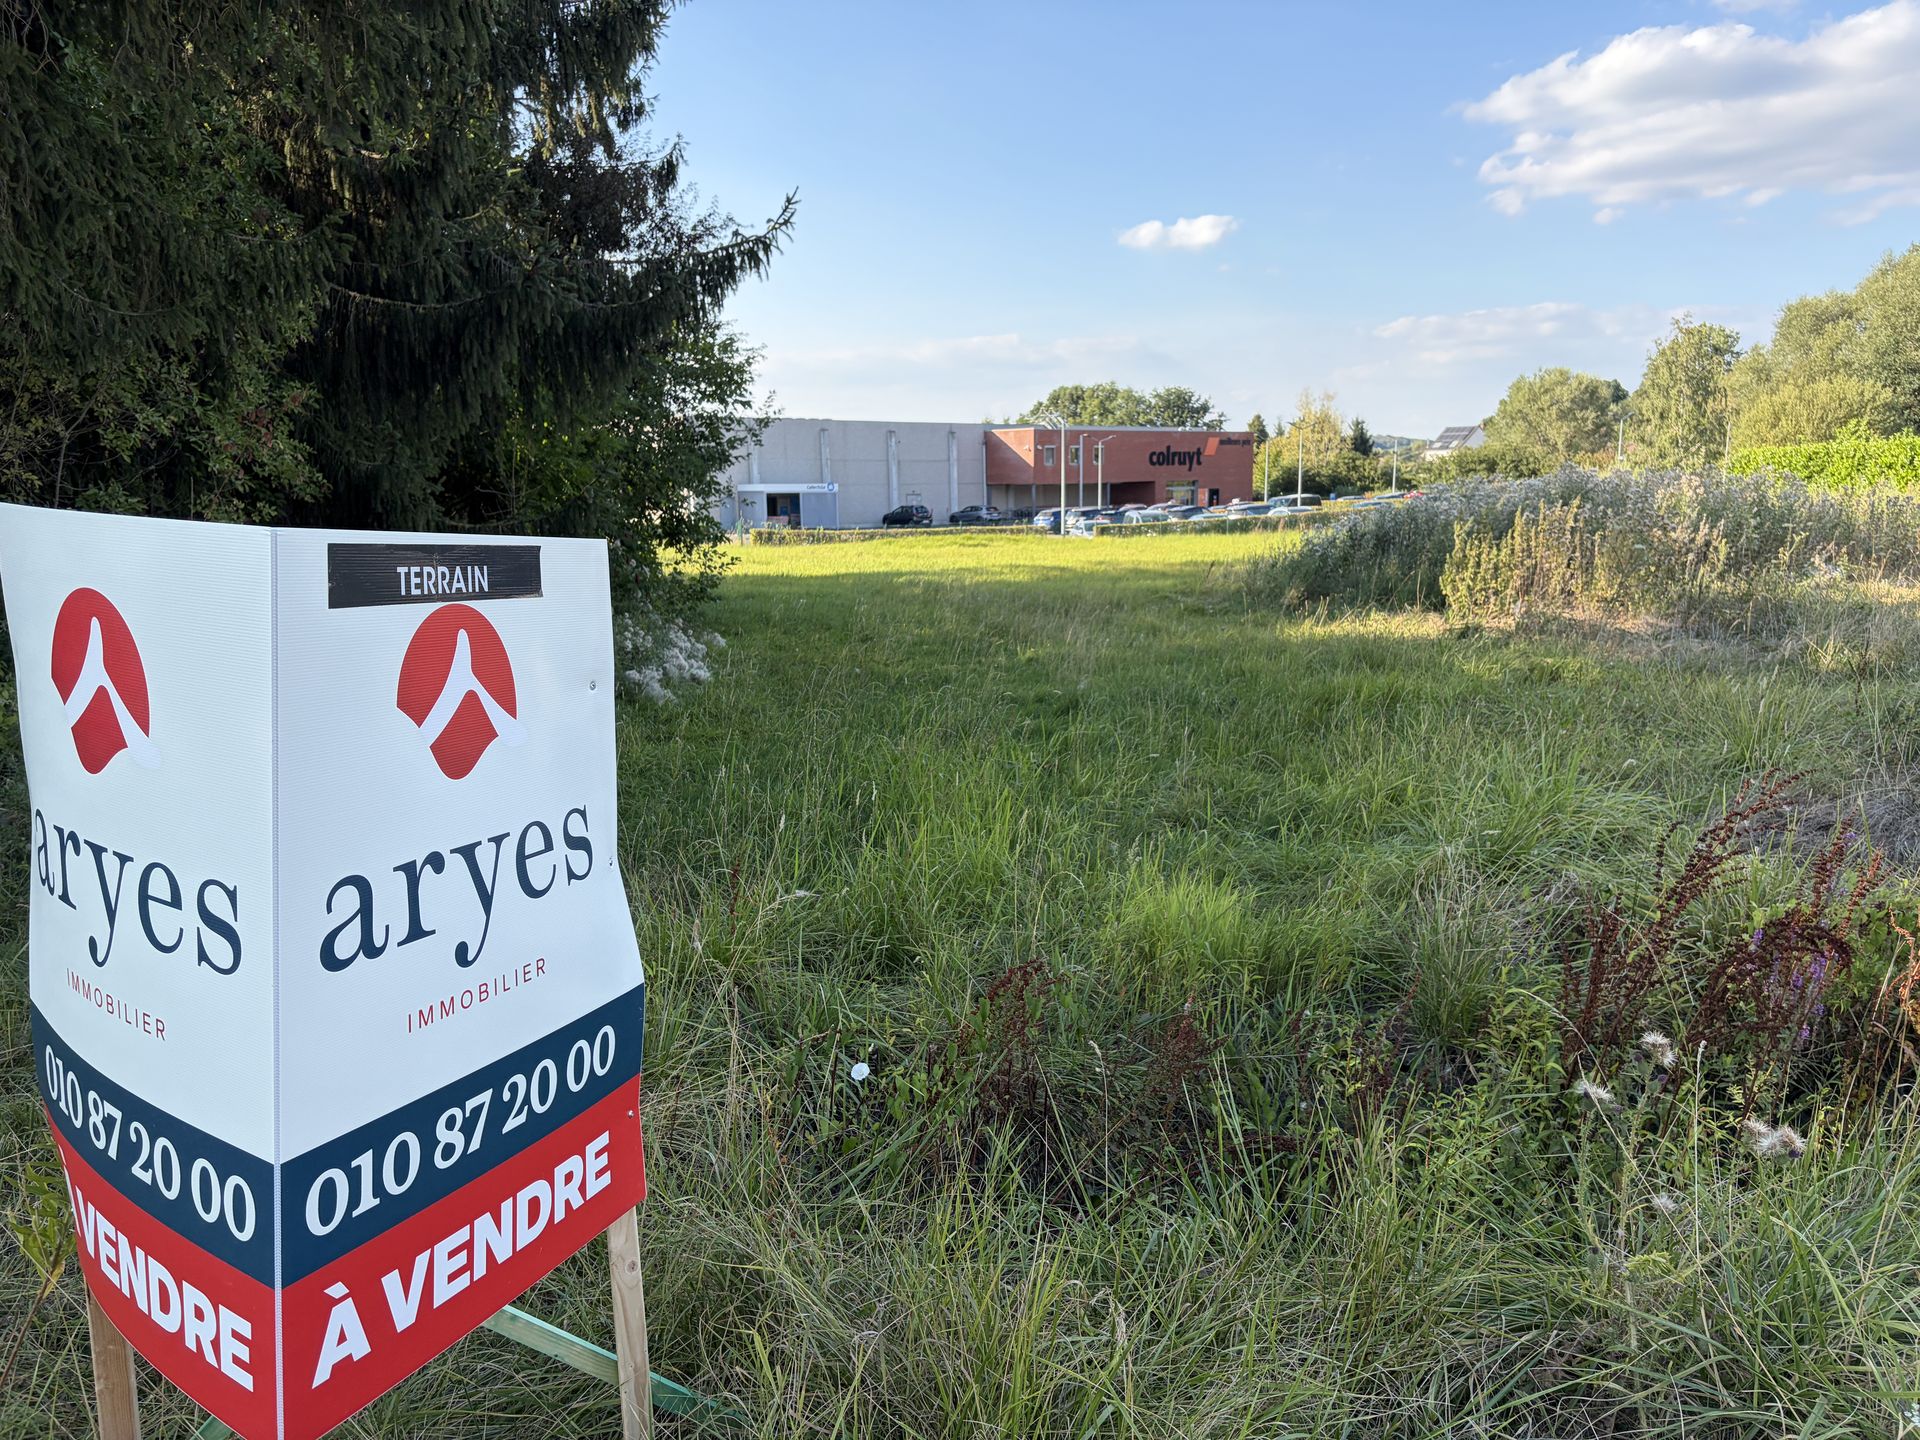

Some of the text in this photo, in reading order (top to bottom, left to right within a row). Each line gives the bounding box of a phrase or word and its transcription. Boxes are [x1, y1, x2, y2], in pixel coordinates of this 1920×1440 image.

[1149, 445, 1202, 472] colruyt
[397, 565, 489, 596] TERRAIN
[34, 808, 242, 976] aryes
[319, 804, 594, 972] aryes
[66, 967, 166, 1041] IMMOBILIER
[408, 957, 547, 1033] IMMOBILIER
[45, 1044, 83, 1129] 010
[87, 1090, 122, 1161] 87
[129, 1121, 181, 1201] 20
[190, 1157, 256, 1242] 00
[305, 1024, 617, 1236] 010 87 20 00
[75, 1185, 254, 1393] VENDRE
[311, 1130, 612, 1390] À VENDRE
